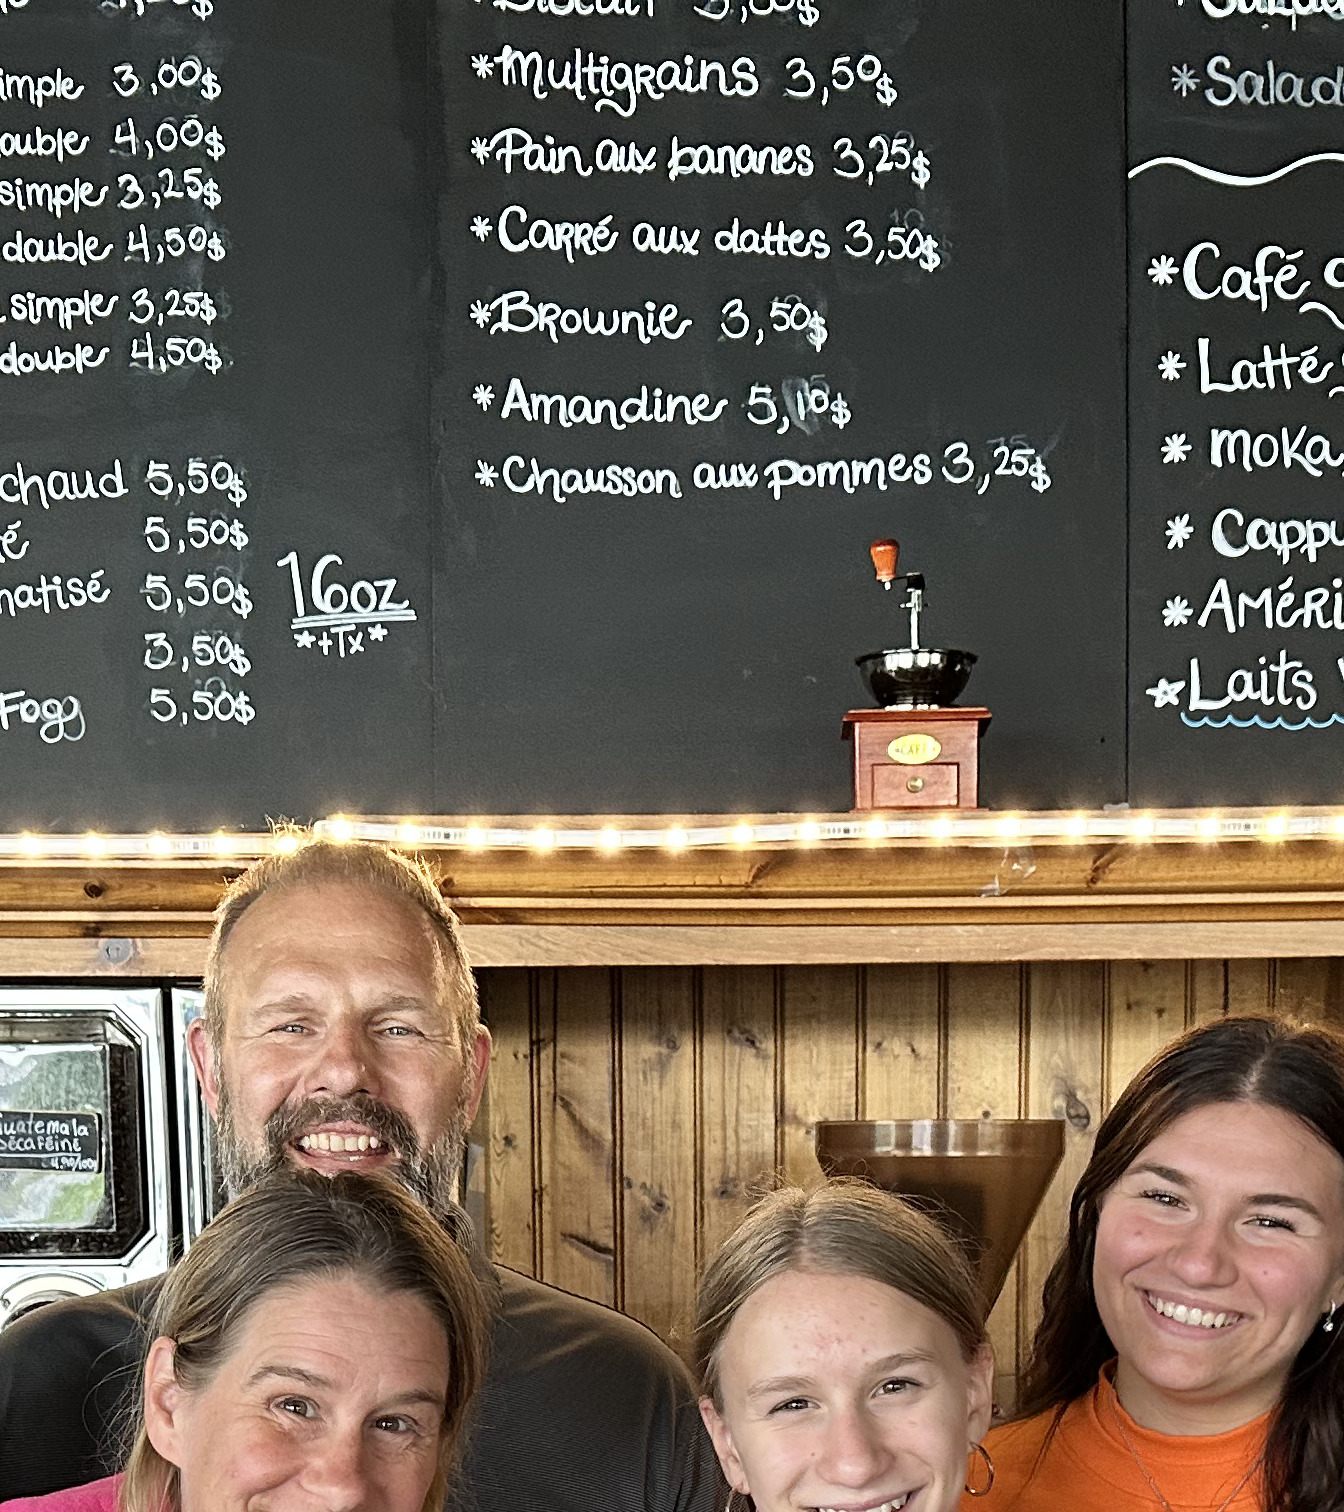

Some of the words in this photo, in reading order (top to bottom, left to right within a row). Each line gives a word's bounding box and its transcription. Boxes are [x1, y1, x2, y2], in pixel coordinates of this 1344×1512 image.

[784, 53, 897, 106] 3,50$
[490, 127, 594, 178] Pain
[595, 137, 657, 178] aux
[667, 134, 815, 181] bananes
[833, 134, 932, 189] 3,25$
[117, 167, 223, 210] 3,25$
[2, 230, 115, 267] double
[124, 224, 227, 267] 4,50$
[631, 221, 701, 257] aux
[714, 218, 831, 260] dattes
[844, 220, 941, 272] 3,50$
[1182, 241, 1311, 312] Café
[9, 285, 119, 330] simple
[128, 287, 217, 326] 3,25$
[720, 298, 828, 351] 3,50$
[129, 331, 223, 376] 4,50$
[1198, 336, 1334, 395] Latté
[500, 377, 729, 429] Amandine
[145, 459, 248, 508] 5,50$
[502, 455, 682, 502] Chausson
[693, 458, 758, 491] aux
[763, 449, 933, 501] pommes
[941, 441, 1052, 495] 3,25$
[144, 516, 249, 557] 5,50$
[145, 574, 254, 619] 5,50$
[276, 550, 410, 618] 16oz
[143, 632, 252, 676] 3,50$
[149, 687, 256, 725] 5,50$
[1188, 650, 1319, 712] Laits
